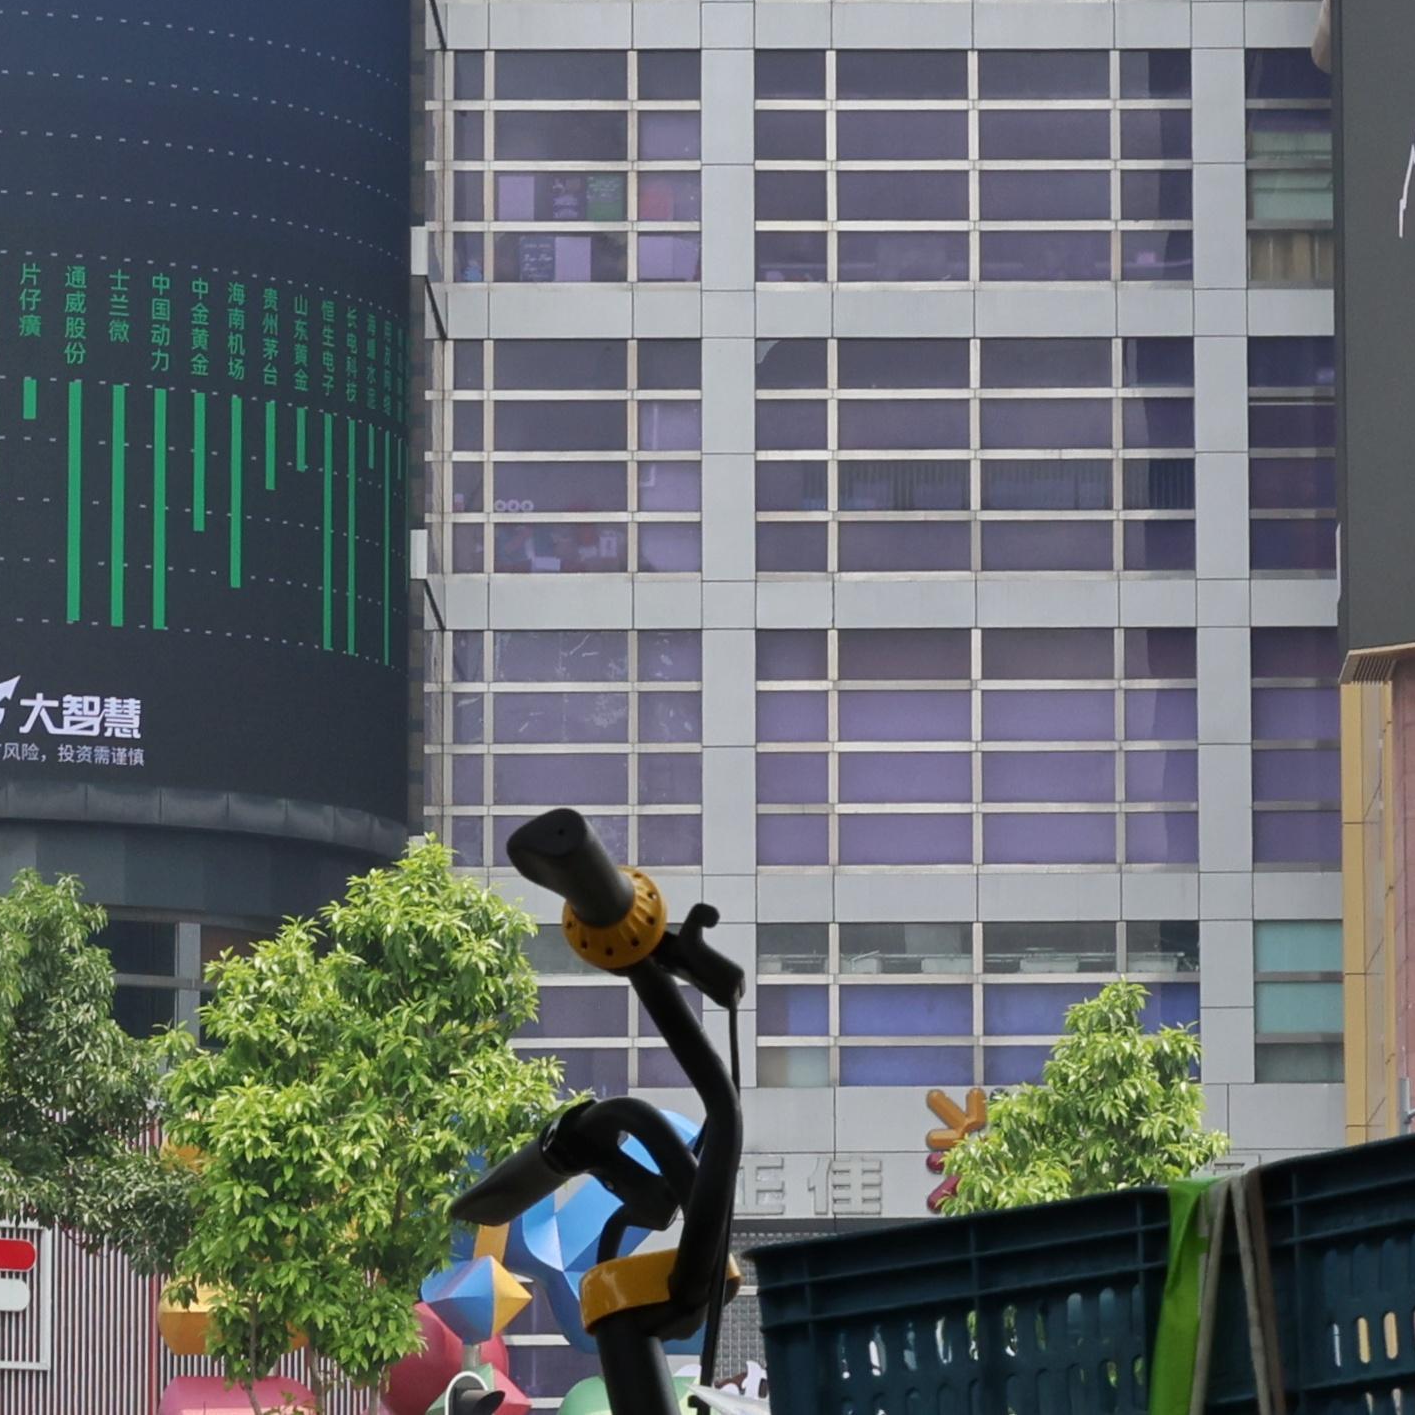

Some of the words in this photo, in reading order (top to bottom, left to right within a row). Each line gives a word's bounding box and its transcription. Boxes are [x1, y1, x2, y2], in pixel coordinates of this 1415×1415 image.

[19, 263, 42, 338] 片仔癀
[64, 265, 87, 365] 通威股份
[108, 268, 130, 343] 士兰微
[151, 272, 171, 372] 中国动力
[191, 277, 210, 377] 中金黄金
[227, 282, 246, 381] 海南机场
[262, 287, 279, 386] 贵州茅台
[294, 294, 309, 392] 山东黄金
[19, 692, 142, 739] 大智慧
